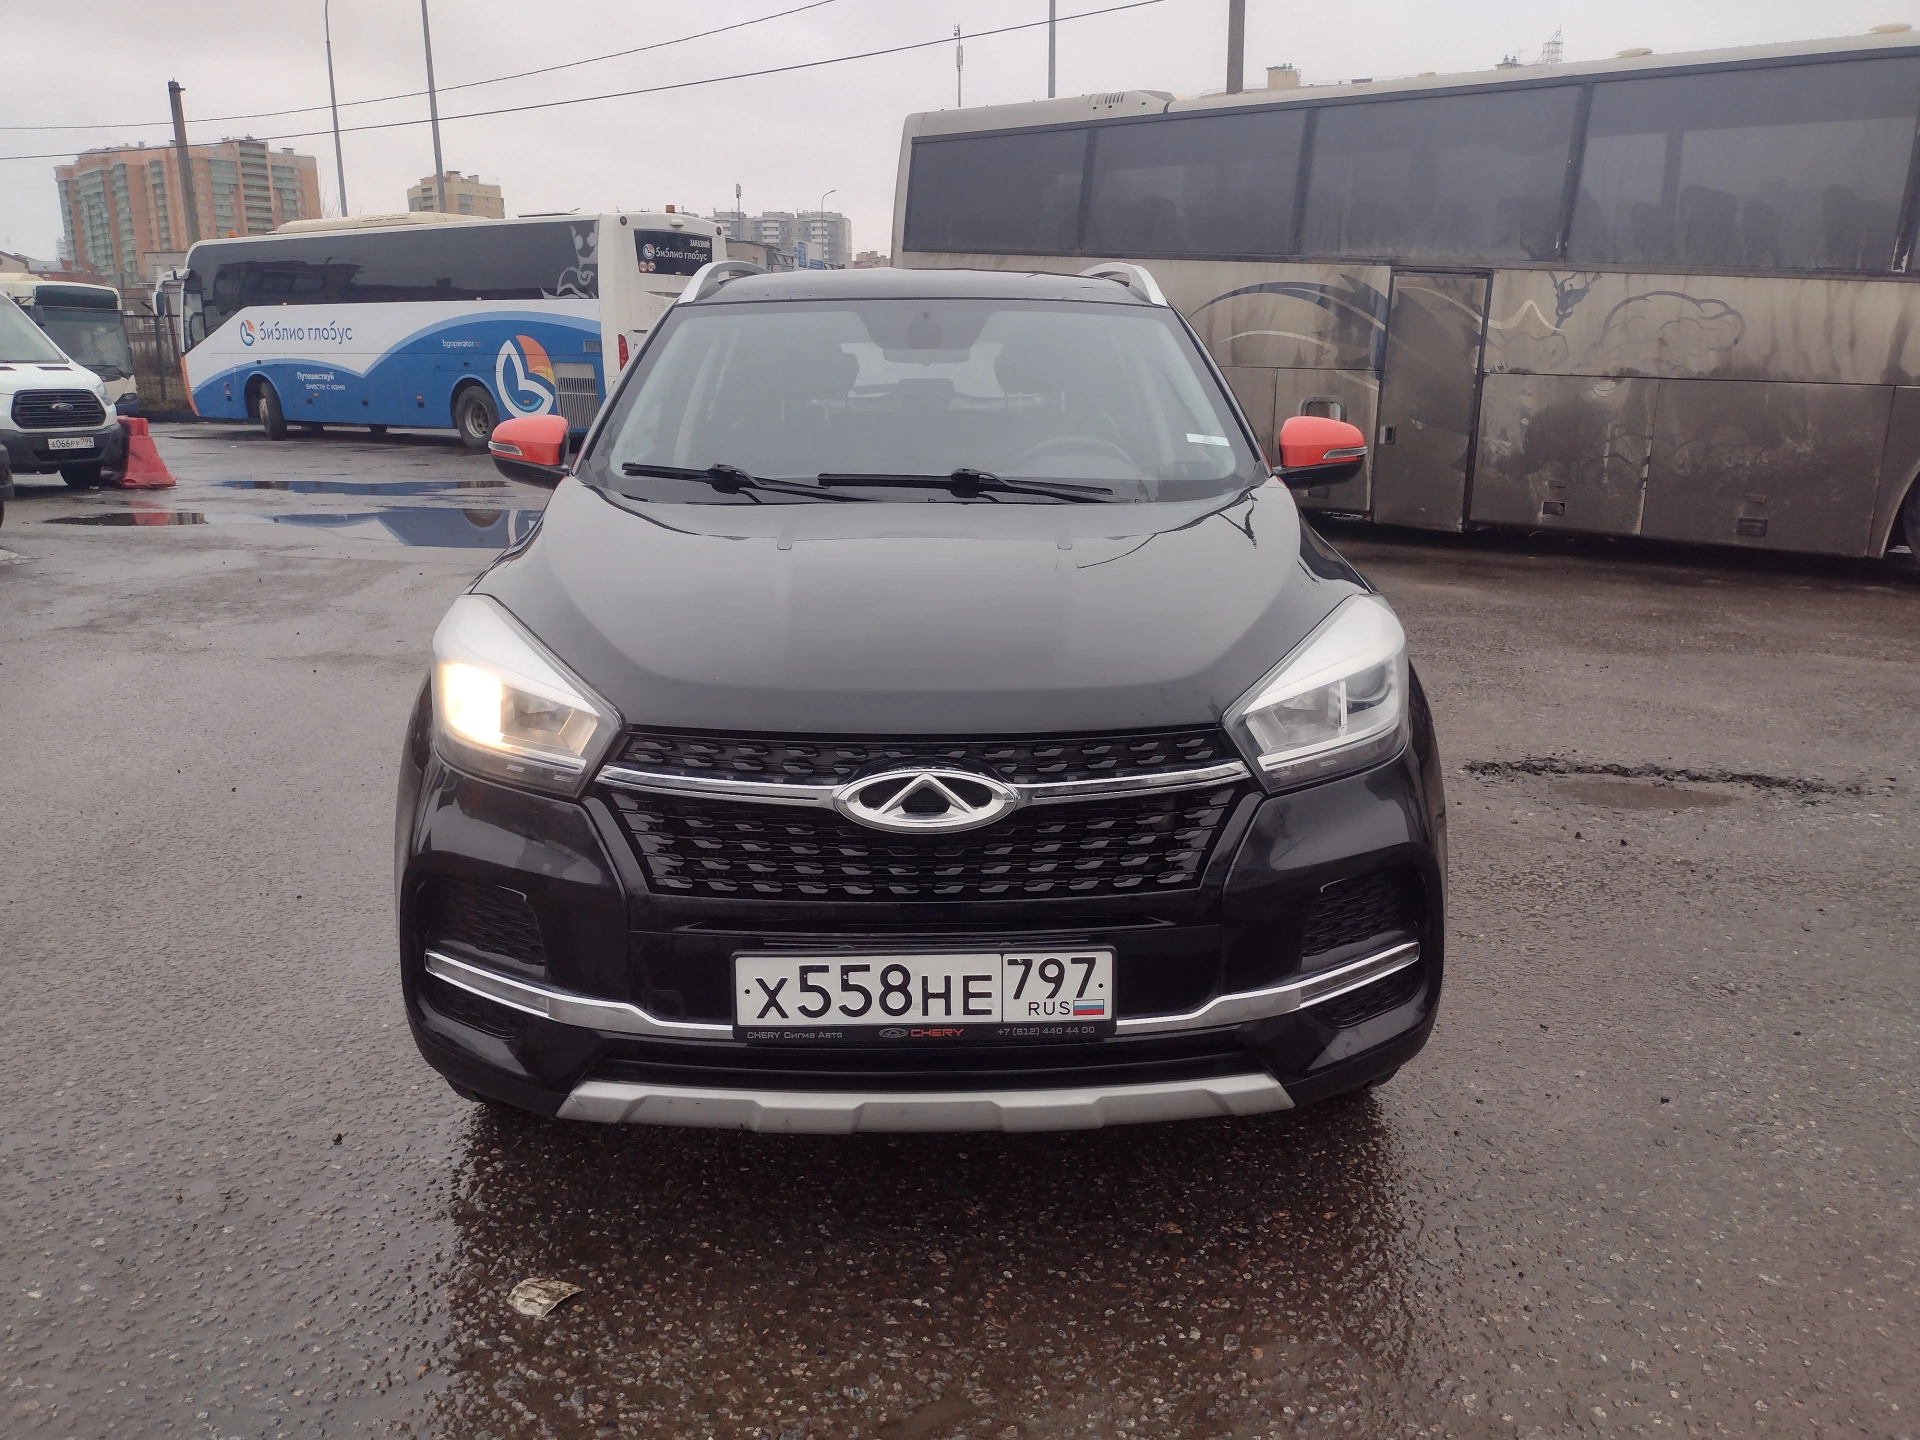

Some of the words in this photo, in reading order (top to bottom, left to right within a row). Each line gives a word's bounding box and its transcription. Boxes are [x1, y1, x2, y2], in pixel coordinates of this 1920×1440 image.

[655, 247, 683, 259] библио
[684, 250, 708, 262] глобус
[259, 321, 305, 341] библио
[307, 320, 353, 345] глобус
[296, 371, 335, 382] Путешествуй
[755, 963, 993, 1018] Х558НЕ
[1007, 957, 1096, 1000] 797
[1028, 1001, 1071, 1016] RUS
[746, 1031, 780, 1039] CHERY
[818, 1031, 843, 1039] Авто
[910, 1028, 964, 1037] CHERY
[997, 1028, 1010, 1036] +7
[1012, 1027, 1040, 1036] (812)
[1042, 1027, 1063, 1035] 440
[1065, 1026, 1079, 1034] 44
[1081, 1026, 1095, 1034] 00
